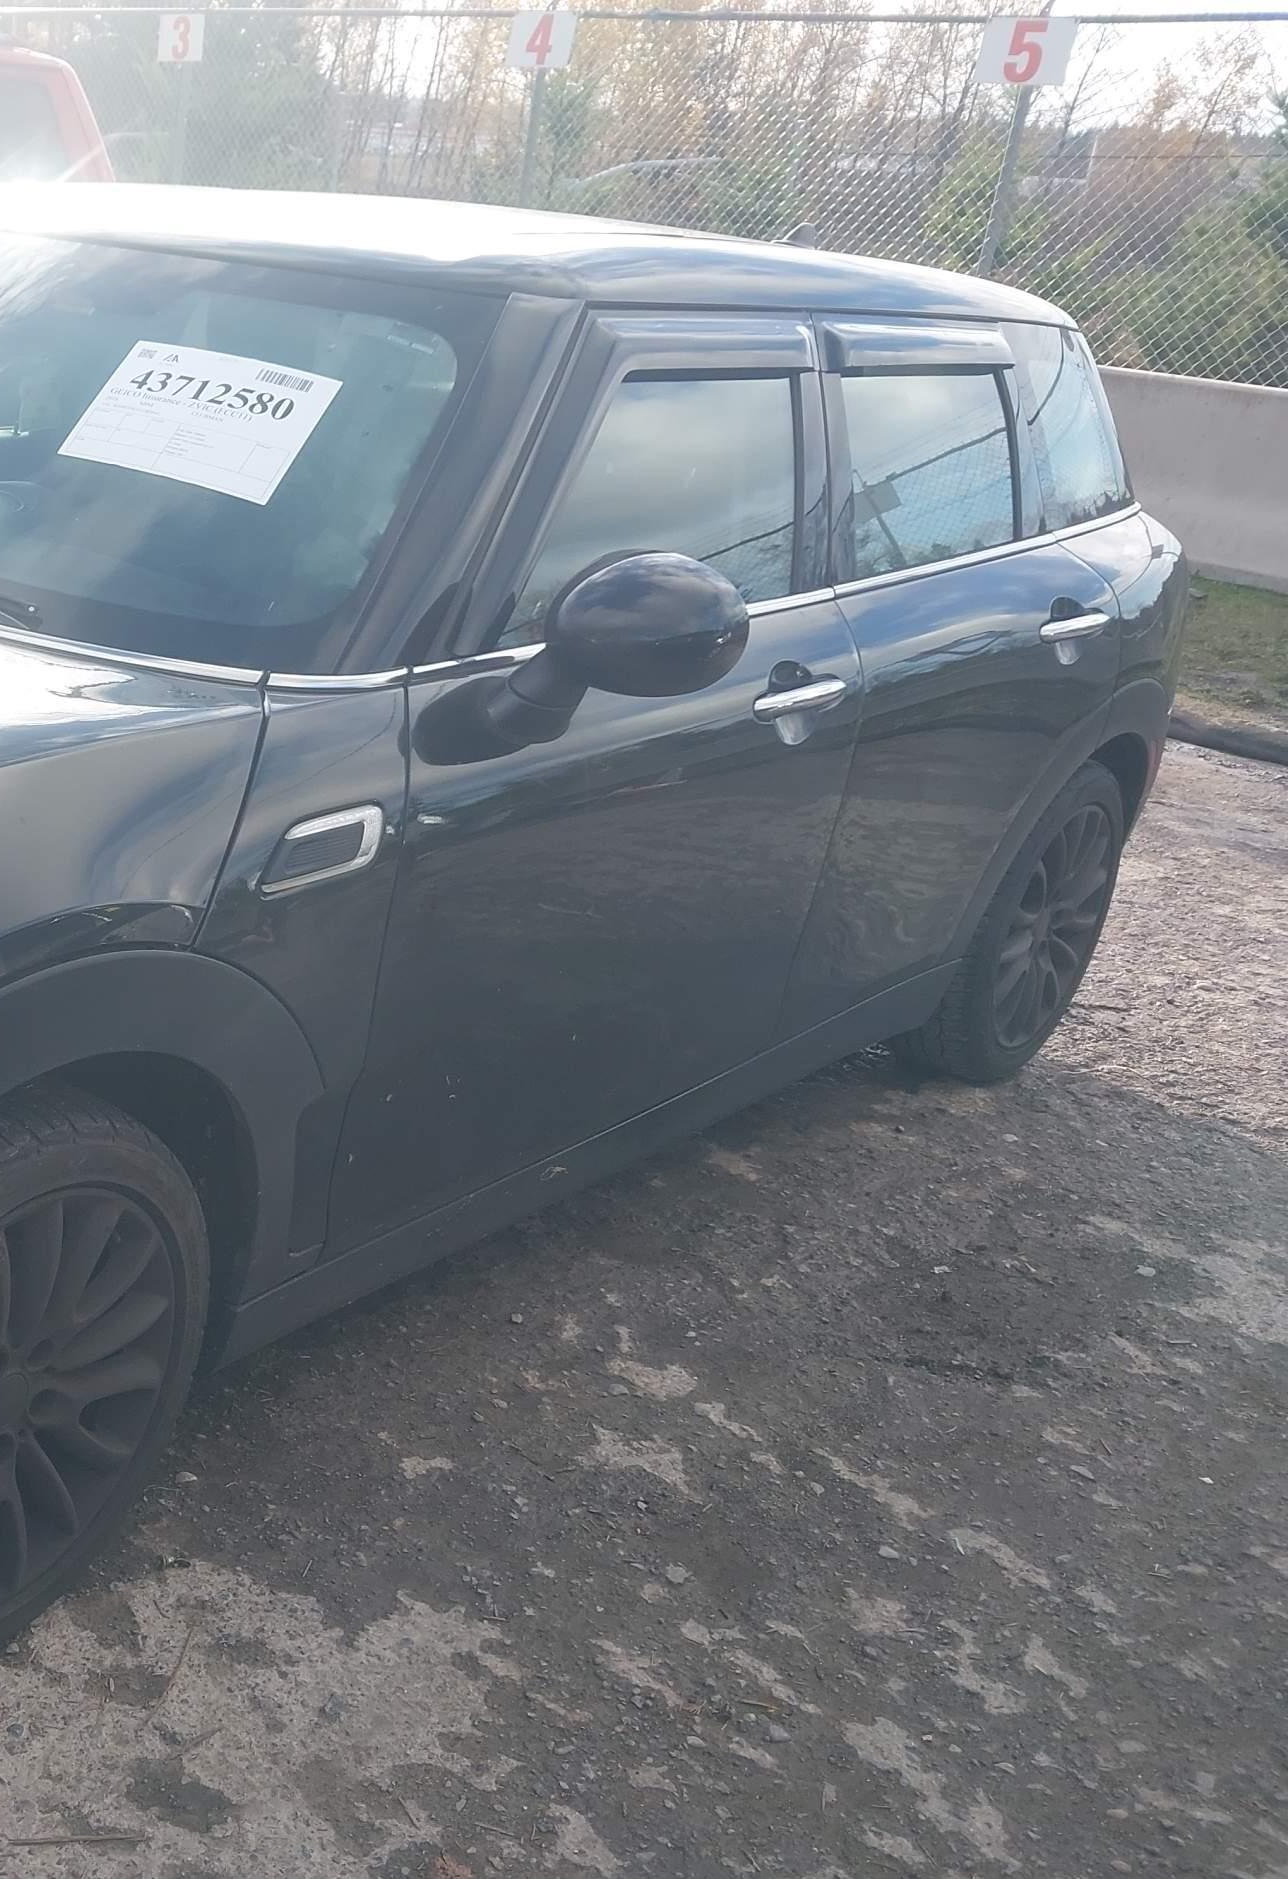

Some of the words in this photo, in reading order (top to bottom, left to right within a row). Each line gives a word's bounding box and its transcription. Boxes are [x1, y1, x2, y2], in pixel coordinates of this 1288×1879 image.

[172, 15, 190, 60] 3
[525, 13, 554, 66] 4
[1003, 20, 1049, 83] 5
[130, 370, 295, 420] 43712580
